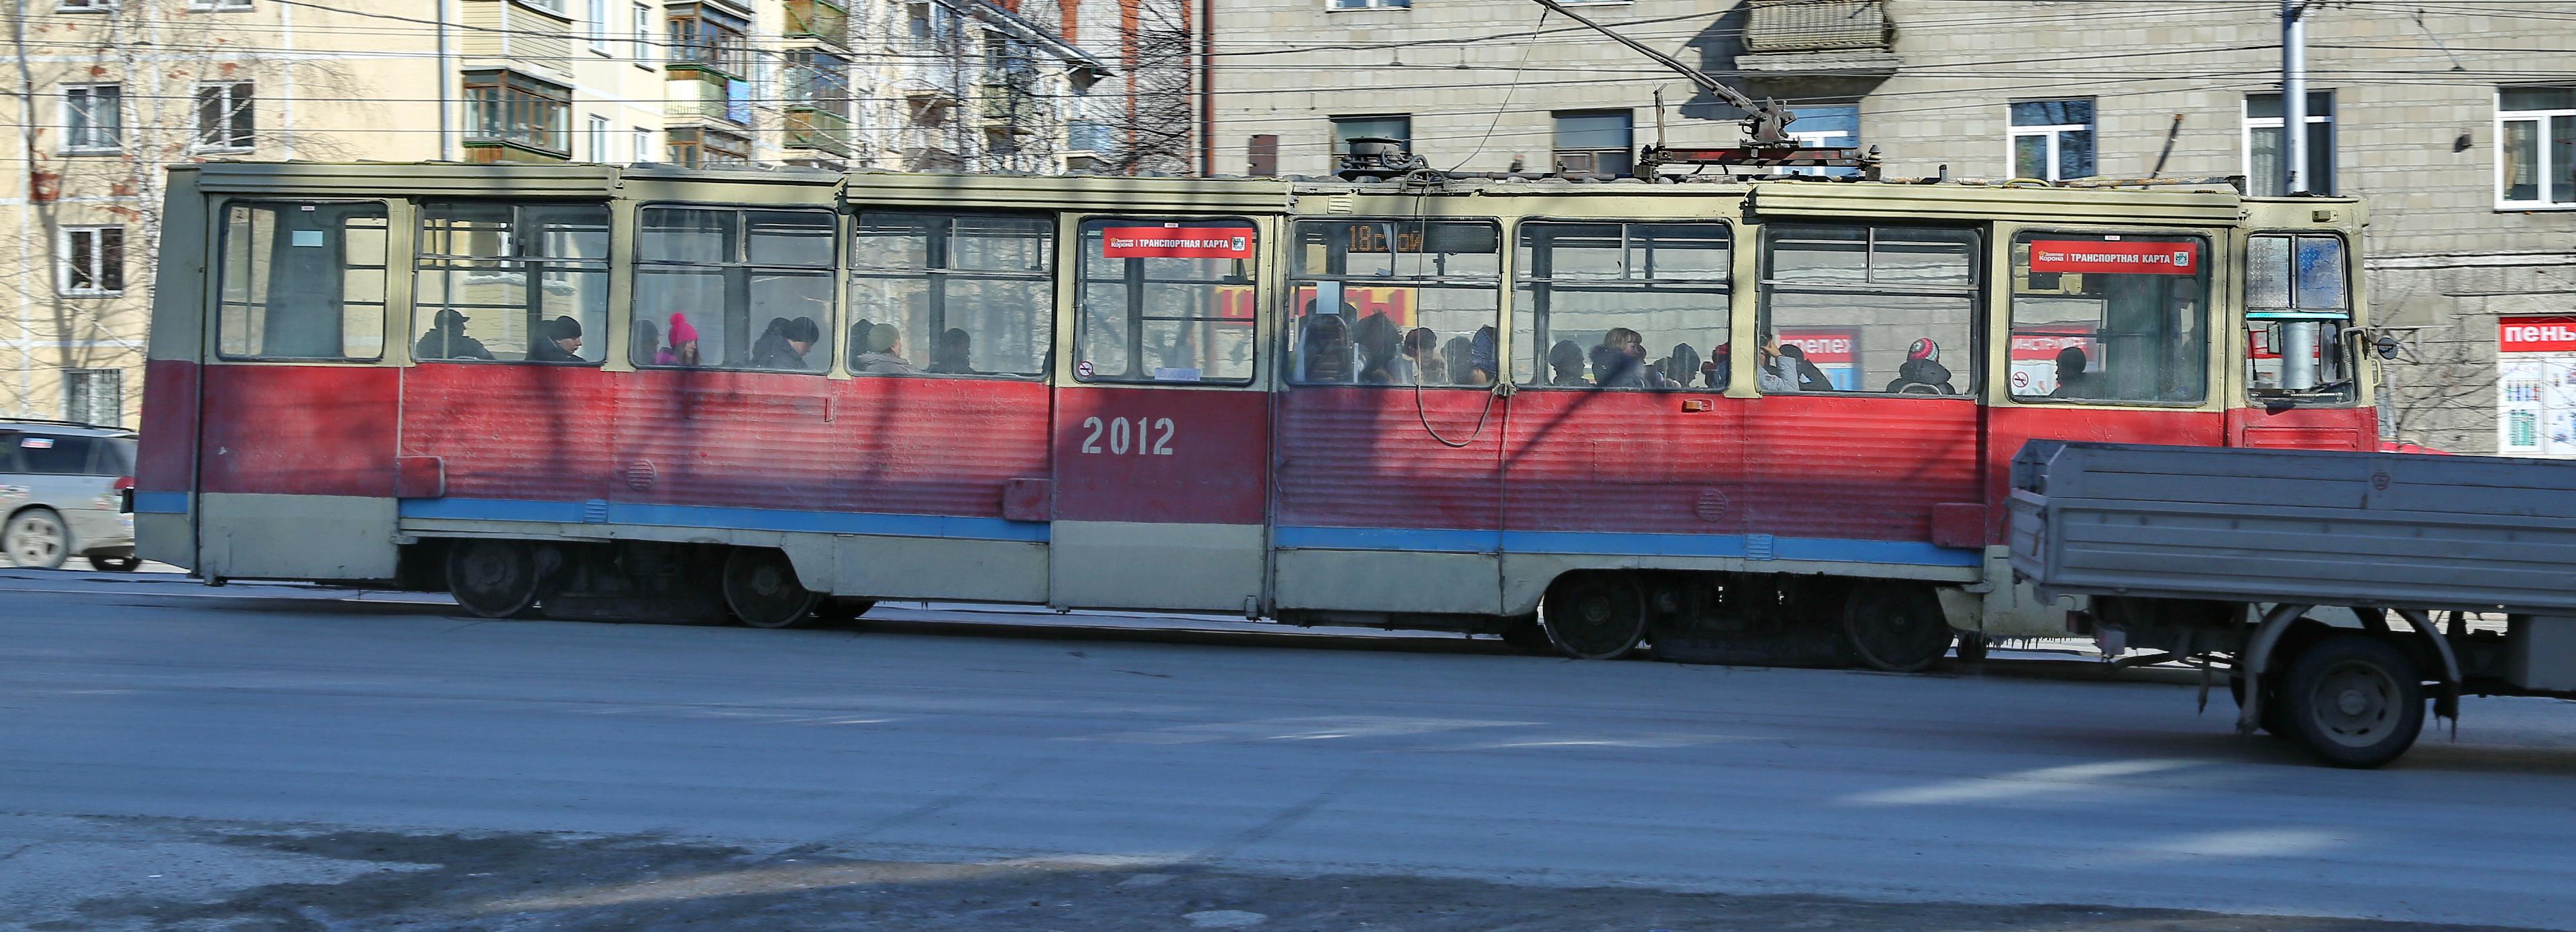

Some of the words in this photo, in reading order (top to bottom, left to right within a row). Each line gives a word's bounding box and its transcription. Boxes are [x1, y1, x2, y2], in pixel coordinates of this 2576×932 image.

[1140, 239, 1200, 249] ТРАНСПОРТНАЯ
[1203, 239, 1229, 249] КАРТА
[1349, 225, 1371, 251] 18
[2071, 253, 2139, 263] ТРАНСПОРТНАЯ
[2142, 254, 2171, 264] КАРТА
[1082, 416, 1174, 455] 2012
